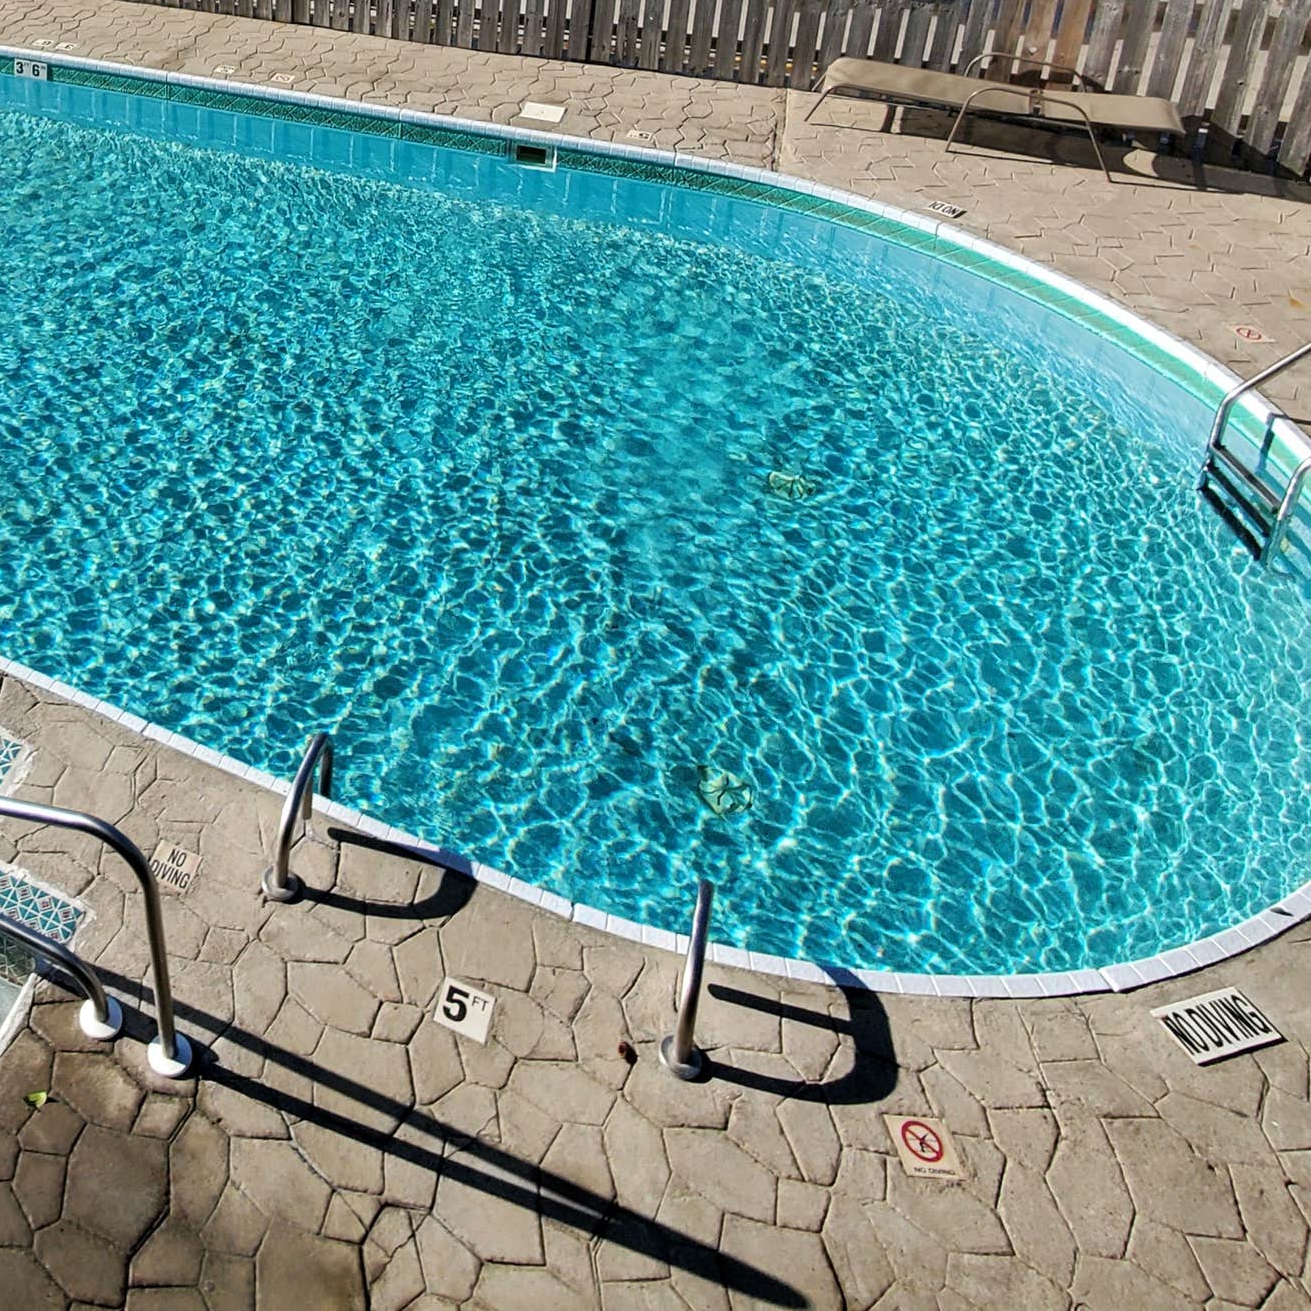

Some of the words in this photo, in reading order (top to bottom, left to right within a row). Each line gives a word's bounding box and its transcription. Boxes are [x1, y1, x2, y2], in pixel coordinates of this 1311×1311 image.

[16, 61, 24, 74] 3
[32, 64, 40, 77] 6
[151, 859, 190, 889] DIVING
[168, 849, 187, 867] NO
[442, 984, 470, 1022] 5
[471, 996, 490, 1011] FT
[1161, 1012, 1210, 1056] NO
[1184, 994, 1273, 1048] DIVING
